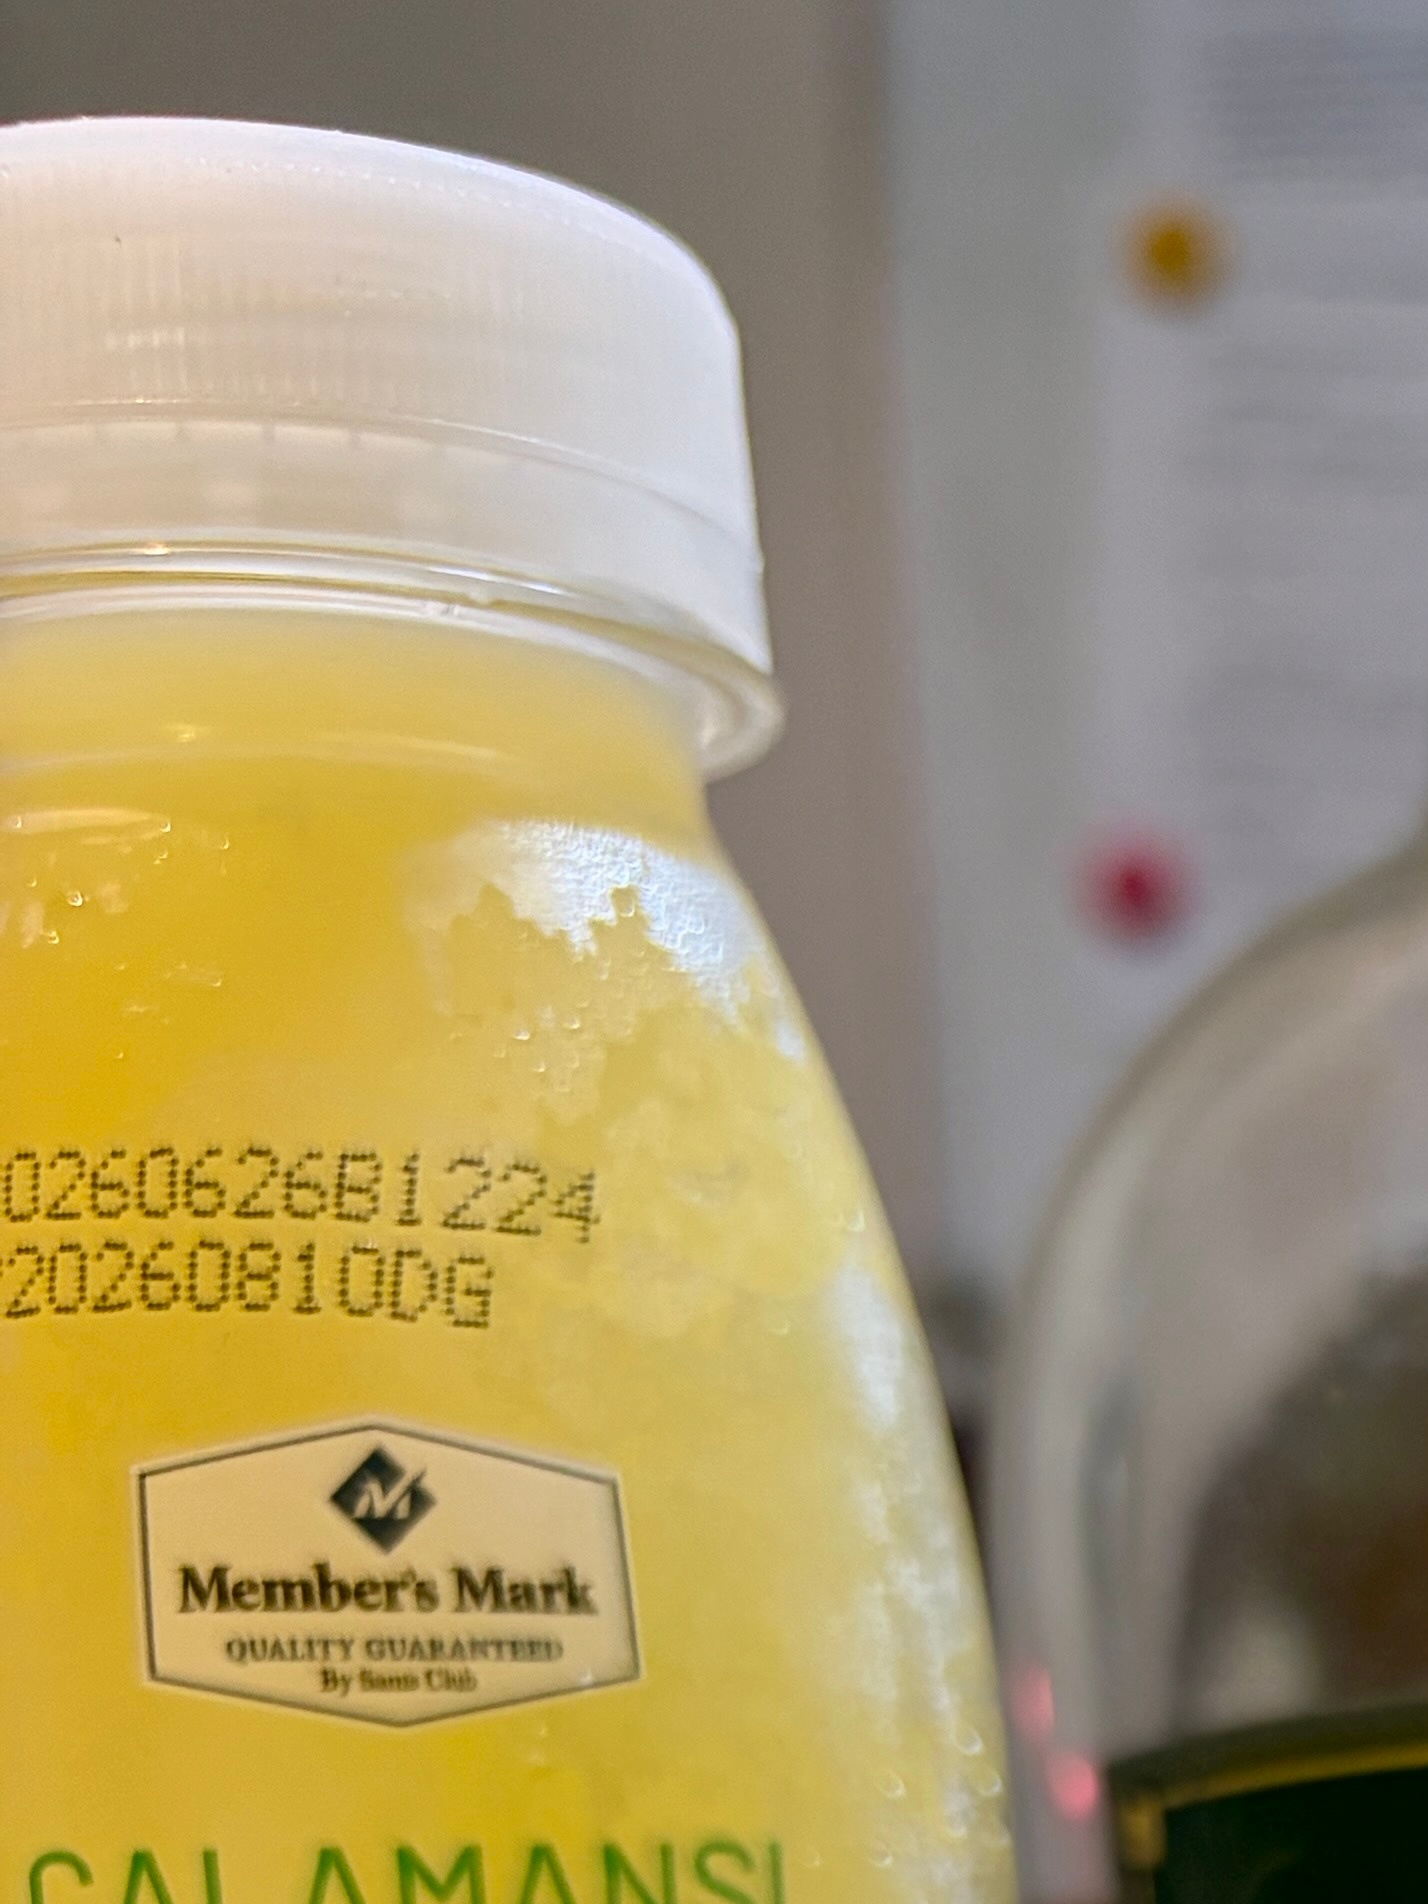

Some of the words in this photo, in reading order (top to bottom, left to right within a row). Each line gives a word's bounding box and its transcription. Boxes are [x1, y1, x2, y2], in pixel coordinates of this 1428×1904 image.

[177, 1560, 439, 1615] Member's
[452, 1562, 598, 1616] Mark
[225, 1636, 356, 1664] QUALITY
[365, 1636, 564, 1662] GUARANTEED
[319, 1668, 352, 1695] By
[425, 1667, 478, 1692] Club
